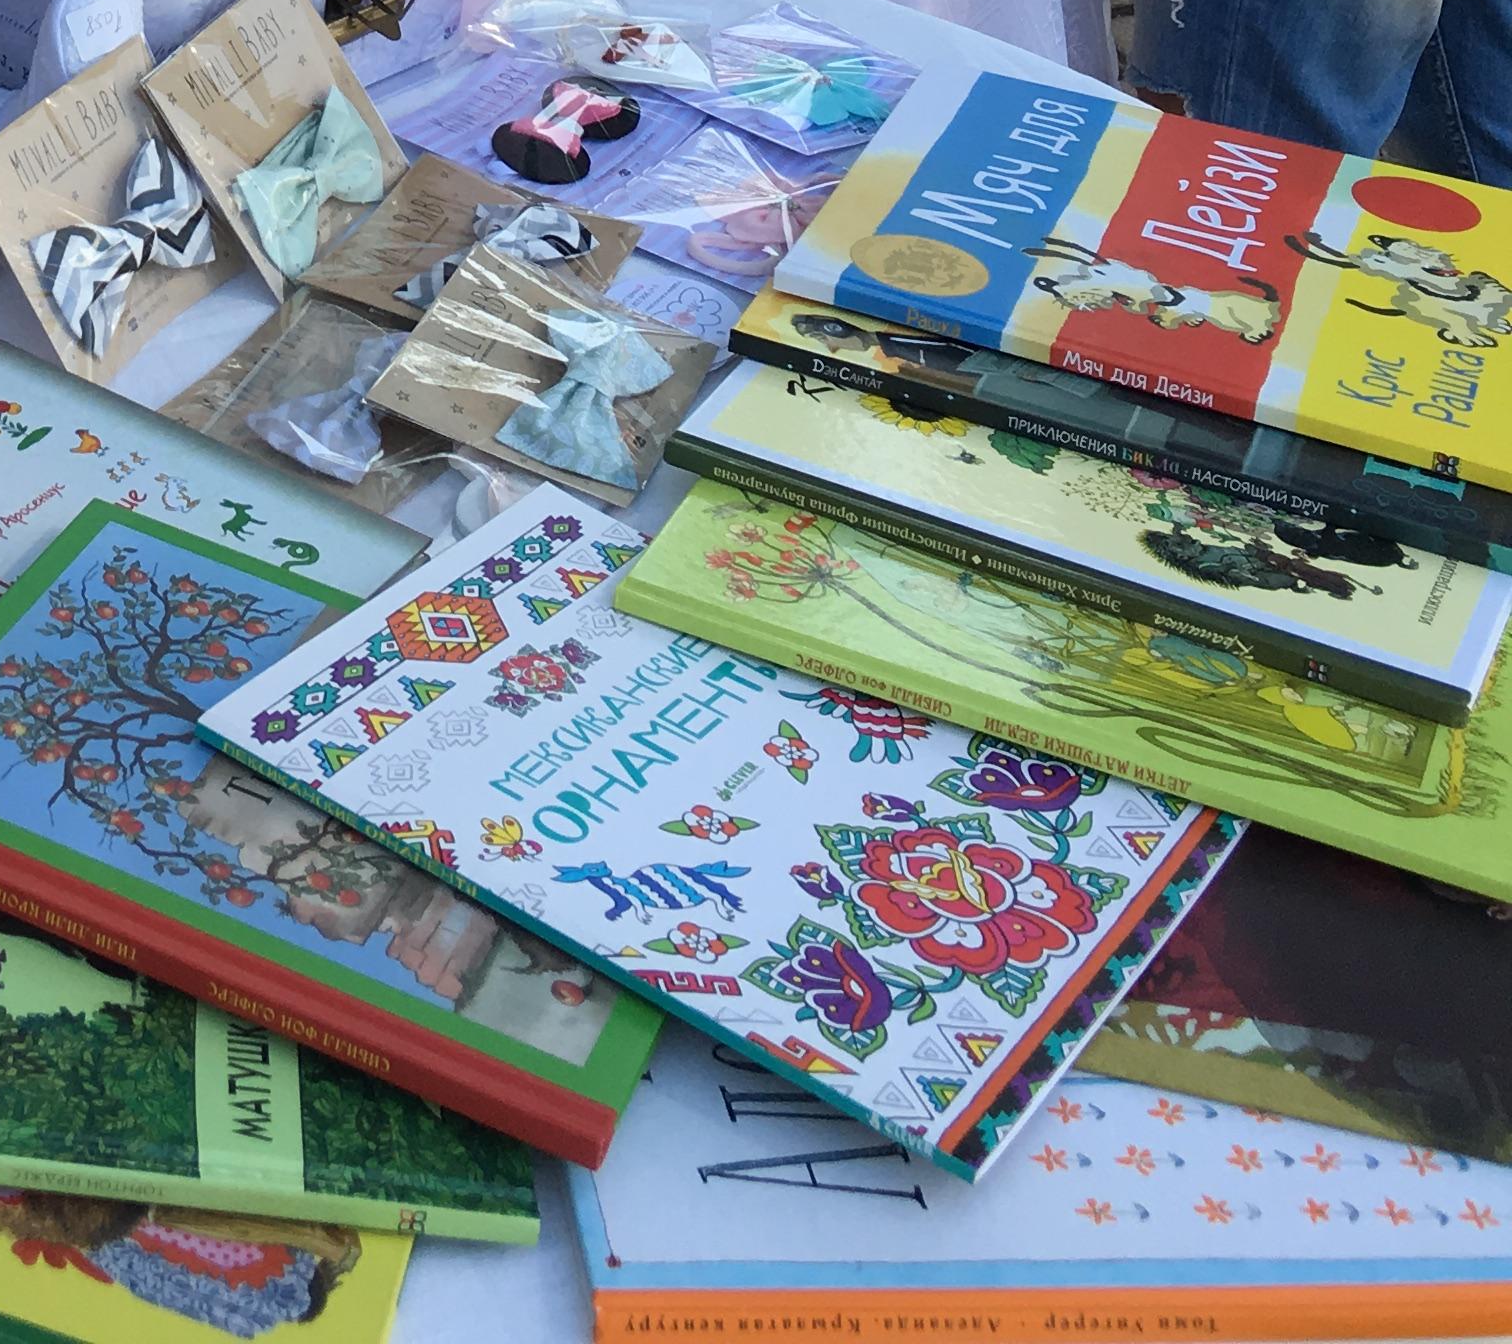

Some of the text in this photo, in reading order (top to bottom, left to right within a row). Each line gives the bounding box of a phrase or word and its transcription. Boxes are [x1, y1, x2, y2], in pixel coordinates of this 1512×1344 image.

[909, 96, 1093, 251] Мяч для
[1140, 138, 1291, 273] Дейзи
[1061, 348, 1215, 409] Мяч для Дейзи
[1336, 347, 1407, 410] Крис
[1411, 347, 1487, 430] Рашка
[1007, 414, 1118, 459] ПРИКЛЮЧЕНИЯ
[1191, 466, 1289, 507] НАСТОЯЩИЙ
[1290, 492, 1330, 516] ДРУГ
[711, 464, 1255, 656] Крапинка Эрих Хайнеманн Иллюстрации Фрица Баумгартена
[794, 652, 857, 687] ОЛФЕРС
[488, 631, 717, 802] МЕКСИКАНСКИЕ
[886, 684, 954, 718] СИБИЛЛ
[983, 714, 1042, 748] ЗЕМЛИ
[1043, 735, 1131, 775] МАТУШКИ
[1130, 761, 1193, 794] ДЕТКИ
[207, 979, 278, 1023] ОЛФЕРС
[281, 1014, 319, 1041] ФОН
[322, 1032, 392, 1073] СИБИЛЛ
[225, 1019, 275, 1143] МАТУШК
[1157, 1314, 1219, 1334] Томи
